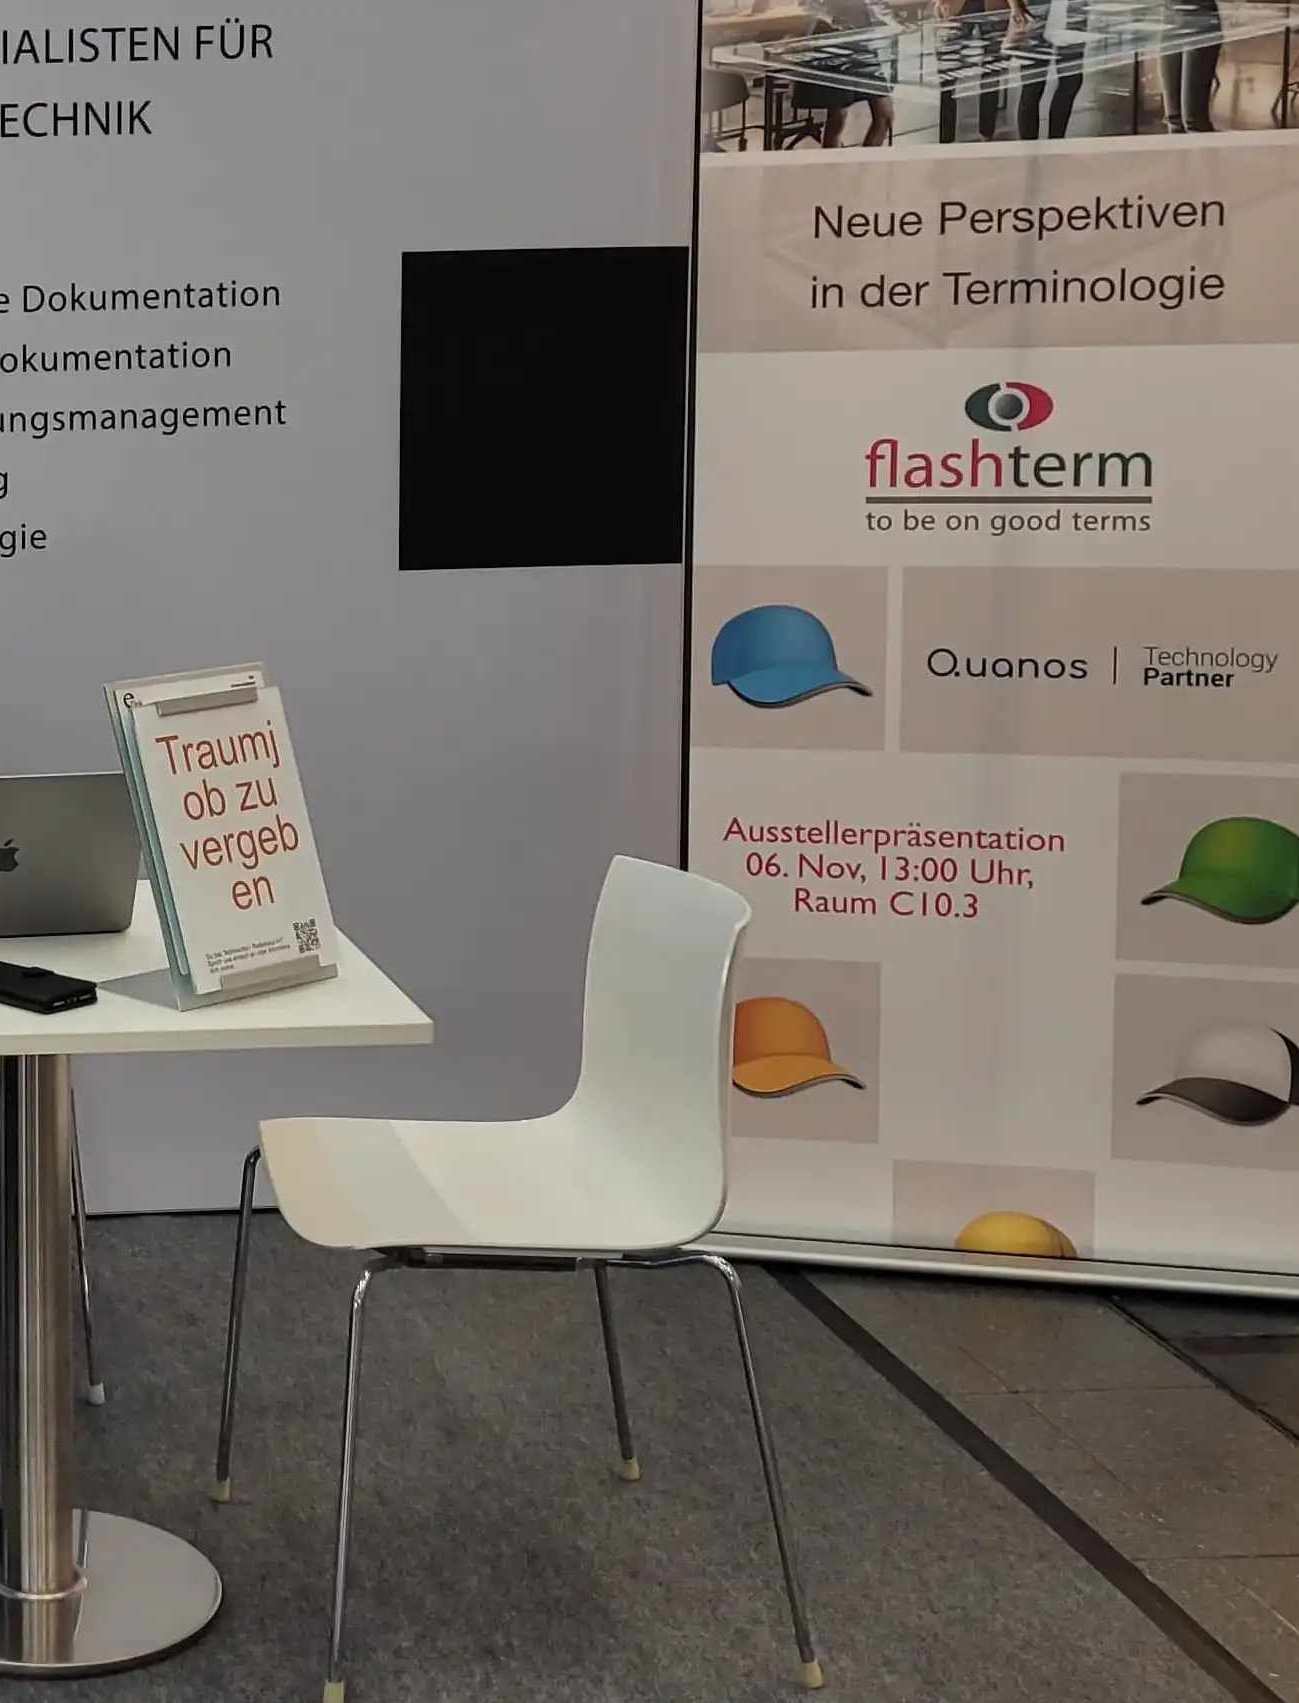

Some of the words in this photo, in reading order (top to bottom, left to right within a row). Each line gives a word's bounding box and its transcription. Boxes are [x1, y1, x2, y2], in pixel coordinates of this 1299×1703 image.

[196, 18, 272, 59] FÜR
[815, 206, 922, 238] Neue
[940, 195, 1224, 240] Perspektiven
[24, 280, 279, 312] Dokumentation
[812, 276, 843, 308] in
[861, 275, 929, 307] der
[943, 266, 1224, 309] Terminologie
[866, 439, 1152, 488] flashterm
[866, 513, 892, 530] to
[904, 509, 935, 530] be
[946, 516, 978, 530] on
[991, 509, 1060, 536] good
[1072, 512, 1150, 531] terms
[928, 649, 1087, 679] Quanos
[1144, 647, 1279, 672] Technology
[1143, 668, 1235, 688] Partner
[155, 719, 280, 775] Traumj
[184, 779, 225, 820] ob
[236, 778, 277, 811] zu
[180, 814, 299, 870] vergeb
[723, 817, 1065, 853] Ausstellerpräsentation
[746, 854, 789, 878] 06.
[799, 854, 865, 883] Nov,
[882, 856, 957, 882] 13:00
[971, 859, 1032, 889] Uhr,
[233, 877, 274, 909] en
[795, 888, 876, 914] Raum
[890, 892, 977, 918] C10.3
